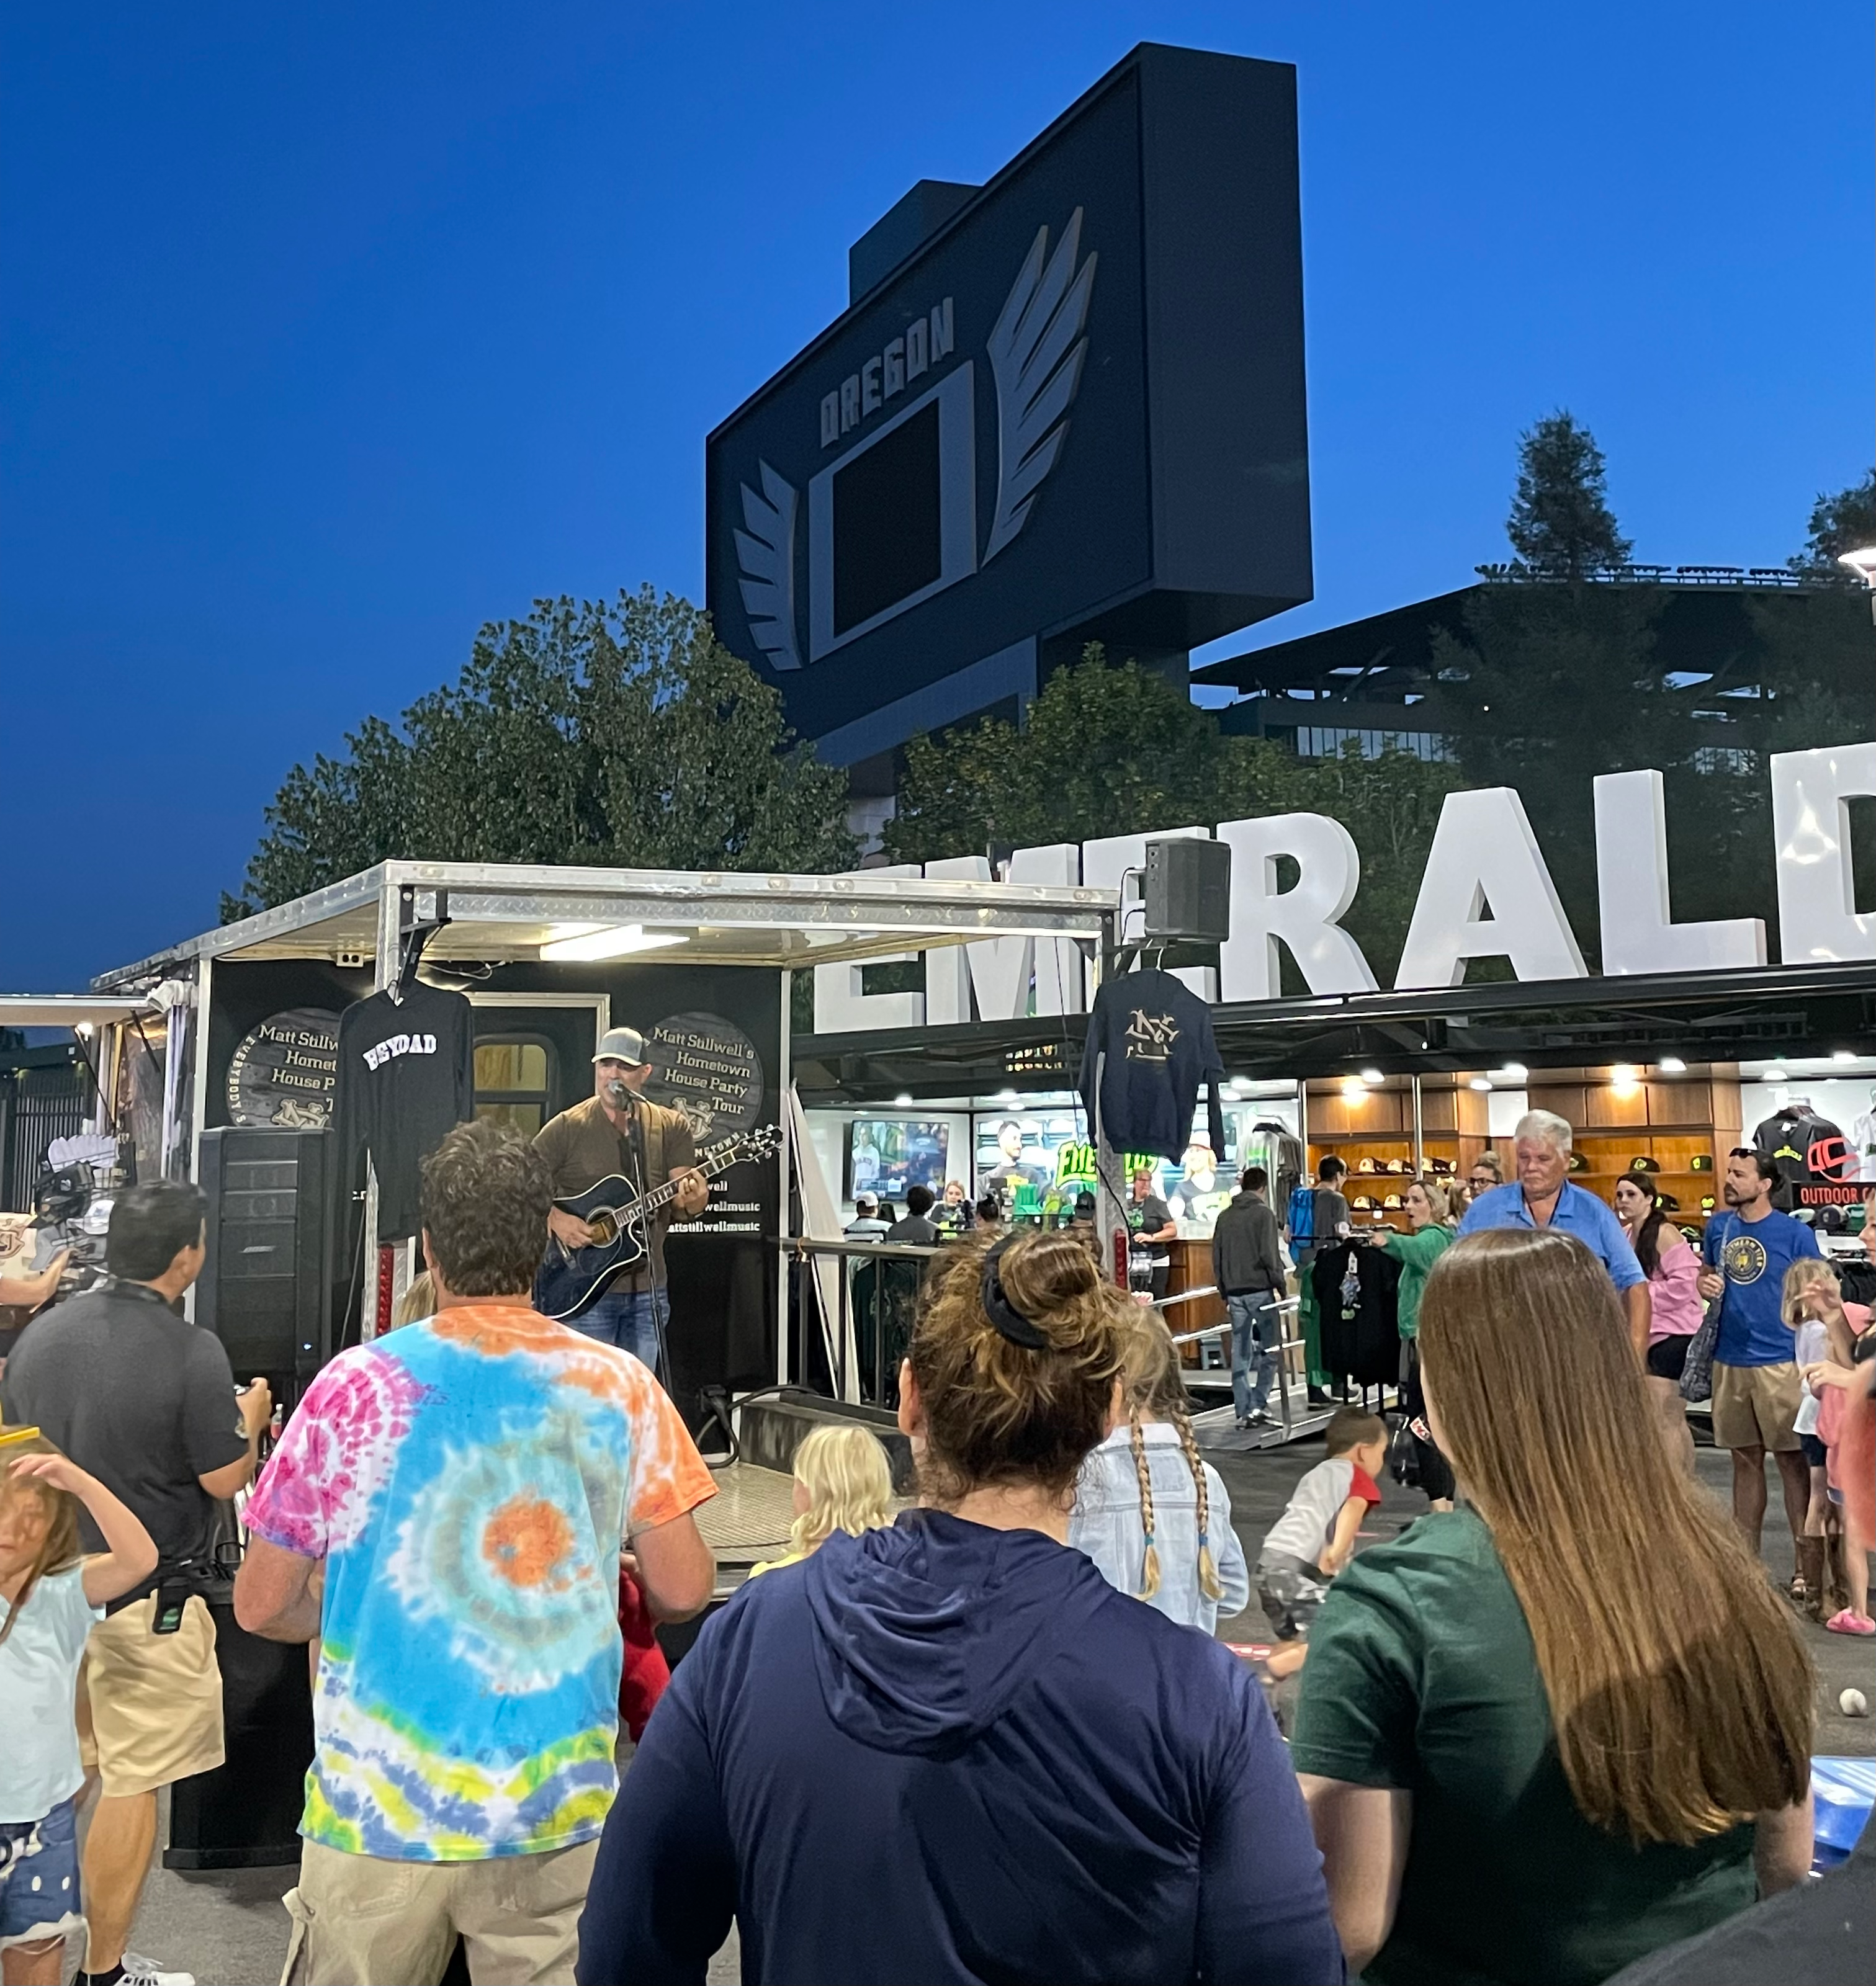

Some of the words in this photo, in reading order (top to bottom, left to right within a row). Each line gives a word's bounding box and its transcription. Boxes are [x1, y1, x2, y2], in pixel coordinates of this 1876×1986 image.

[821, 297, 954, 449] OREGON
[259, 1024, 296, 1045] Matt
[653, 1027, 686, 1045] Matt
[687, 1034, 755, 1059] Stillwell's
[676, 1051, 750, 1078] Hometown
[272, 1068, 321, 1089] House
[665, 1068, 707, 1088] House
[709, 1076, 748, 1098] Party
[712, 1096, 745, 1114] Tour
[1801, 1187, 1859, 1204] OUTDOOR
[667, 1220, 761, 1233] attstillwellmusic
